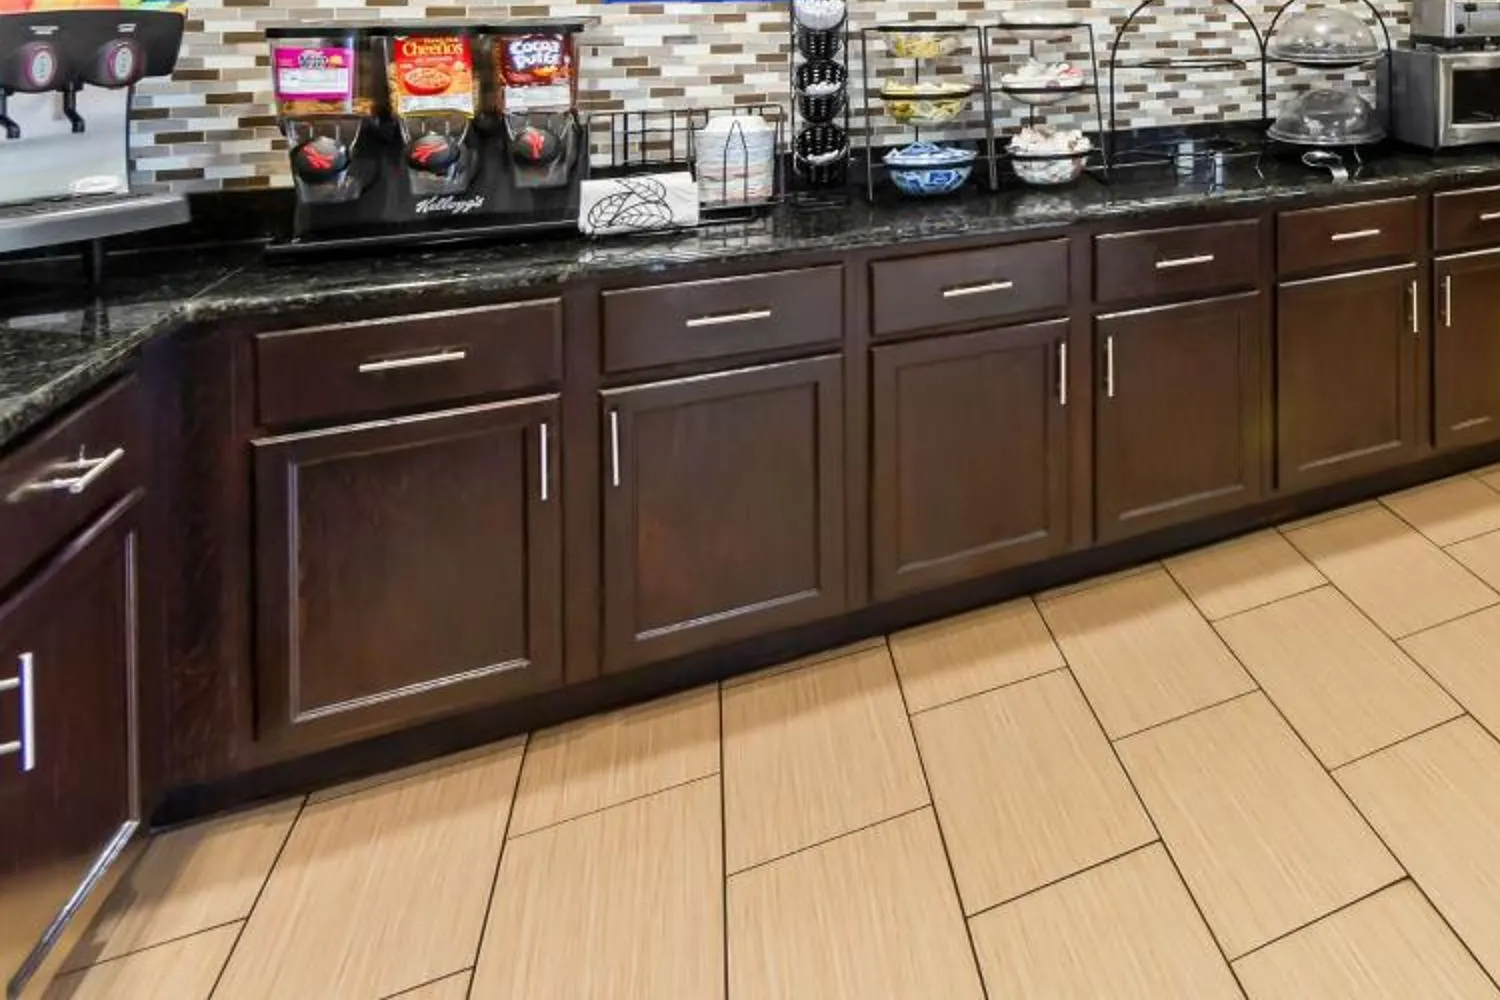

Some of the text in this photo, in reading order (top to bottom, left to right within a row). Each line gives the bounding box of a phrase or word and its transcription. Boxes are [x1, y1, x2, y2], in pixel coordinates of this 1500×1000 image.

[402, 40, 464, 56] Cheerios
[509, 40, 561, 55] Cocoa
[415, 195, 485, 214] Kellogg's
